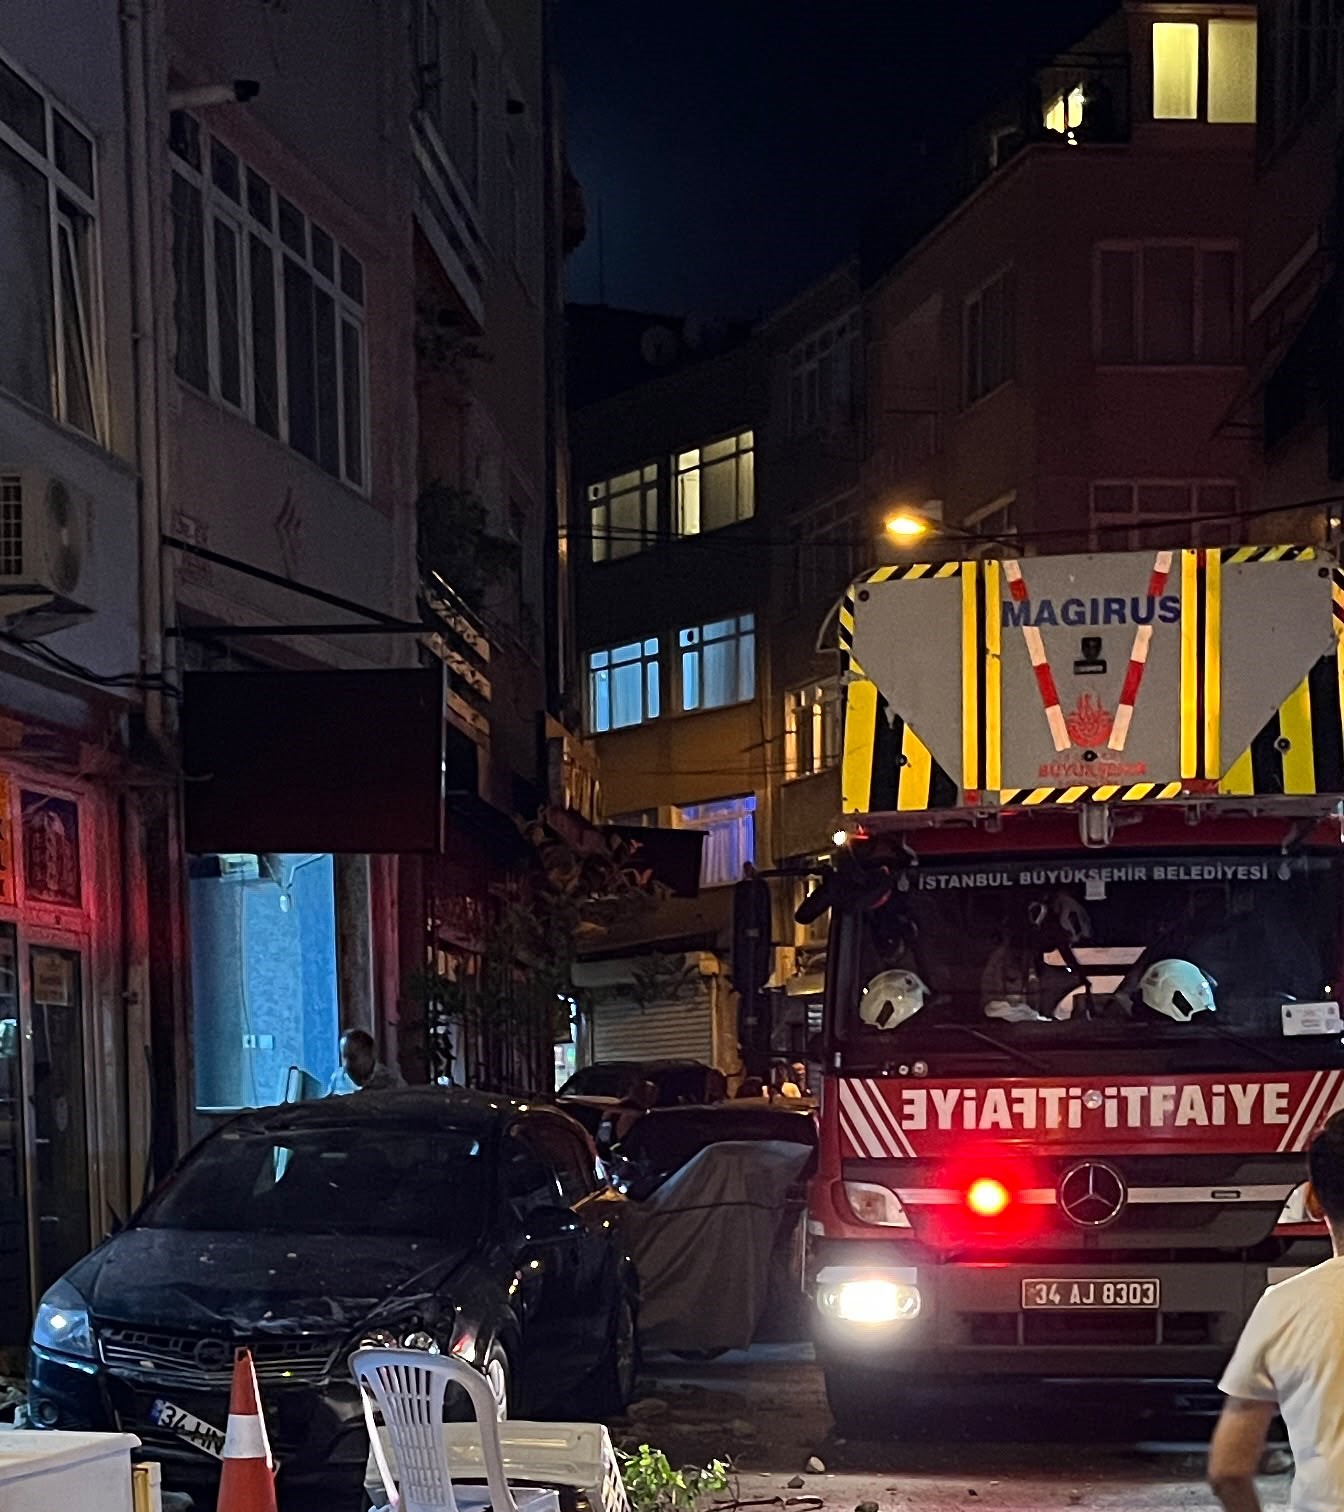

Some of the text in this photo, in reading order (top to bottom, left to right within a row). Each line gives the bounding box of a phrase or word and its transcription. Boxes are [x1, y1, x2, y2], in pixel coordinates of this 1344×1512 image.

[1002, 595, 1181, 627] MAGIRUS
[919, 872, 1013, 891] İSTANBUL
[1153, 862, 1269, 882] BELEDİYESİ
[1036, 1282, 1155, 1305] 34 AJ 8303
